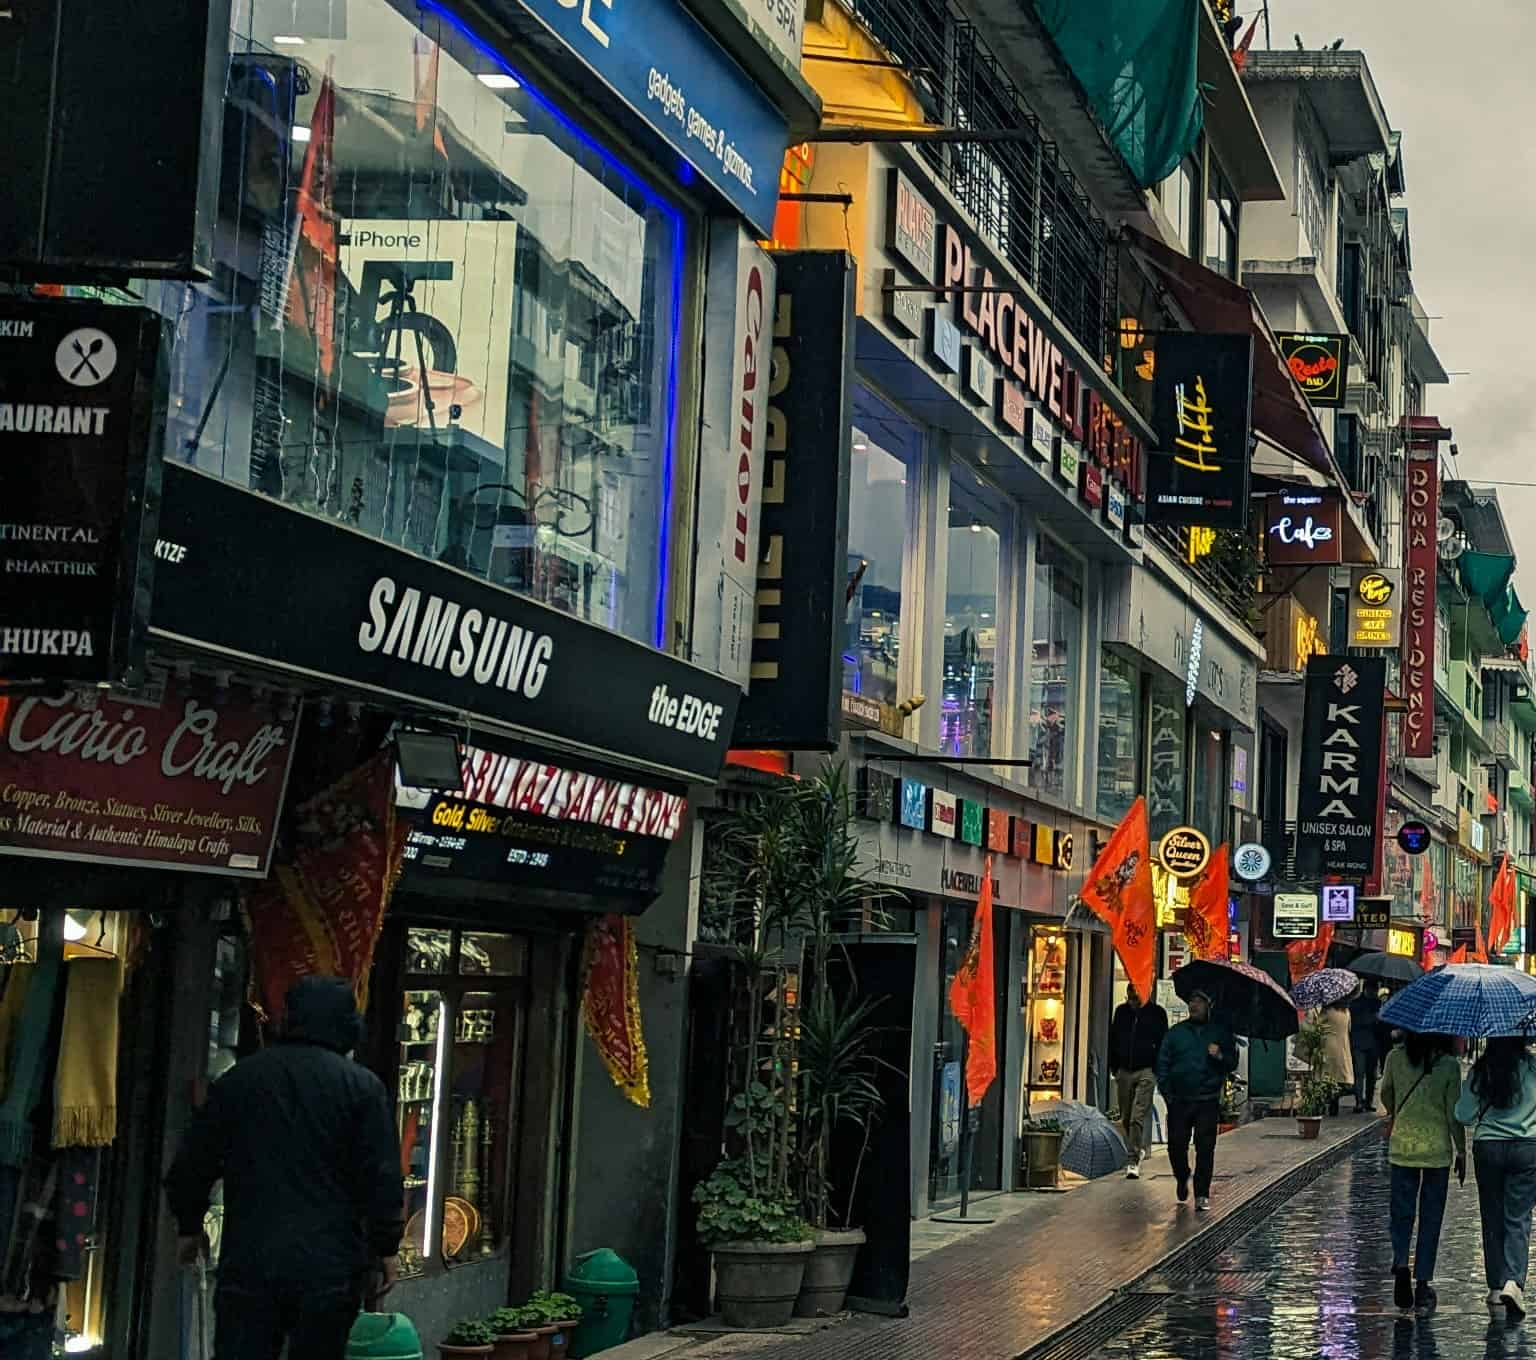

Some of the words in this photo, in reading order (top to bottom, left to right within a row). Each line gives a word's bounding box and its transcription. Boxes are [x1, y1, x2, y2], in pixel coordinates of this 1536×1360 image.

[647, 66, 686, 129] gadgets,
[686, 106, 717, 153] games
[715, 128, 725, 160] &
[354, 230, 422, 249] iPhone
[0, 319, 34, 338] KIM
[944, 225, 1084, 441] PLACEWELL
[0, 403, 110, 436] AURANT
[734, 264, 764, 564] Canon
[1409, 467, 1430, 548] DOMA
[2, 627, 94, 657] HUKPA
[358, 576, 554, 700] SAMSUNG
[1407, 567, 1427, 749] RESIDENCY
[647, 684, 679, 726] the
[678, 694, 724, 741] EDGE
[161, 699, 286, 795] Craft
[1316, 702, 1363, 819] KARMA
[54, 791, 101, 816] Bronze,
[102, 797, 148, 822] Statues,
[432, 801, 464, 833] Gold,
[1301, 821, 1337, 836] UNISEX
[1338, 822, 1372, 837] SALON
[15, 811, 71, 839] Material
[70, 820, 83, 840] &
[83, 820, 142, 847] Authentic
[142, 827, 197, 855] Himalaya
[197, 835, 230, 859] Crafts
[1165, 846, 1202, 861] Queen
[1331, 840, 1347, 853] SPA
